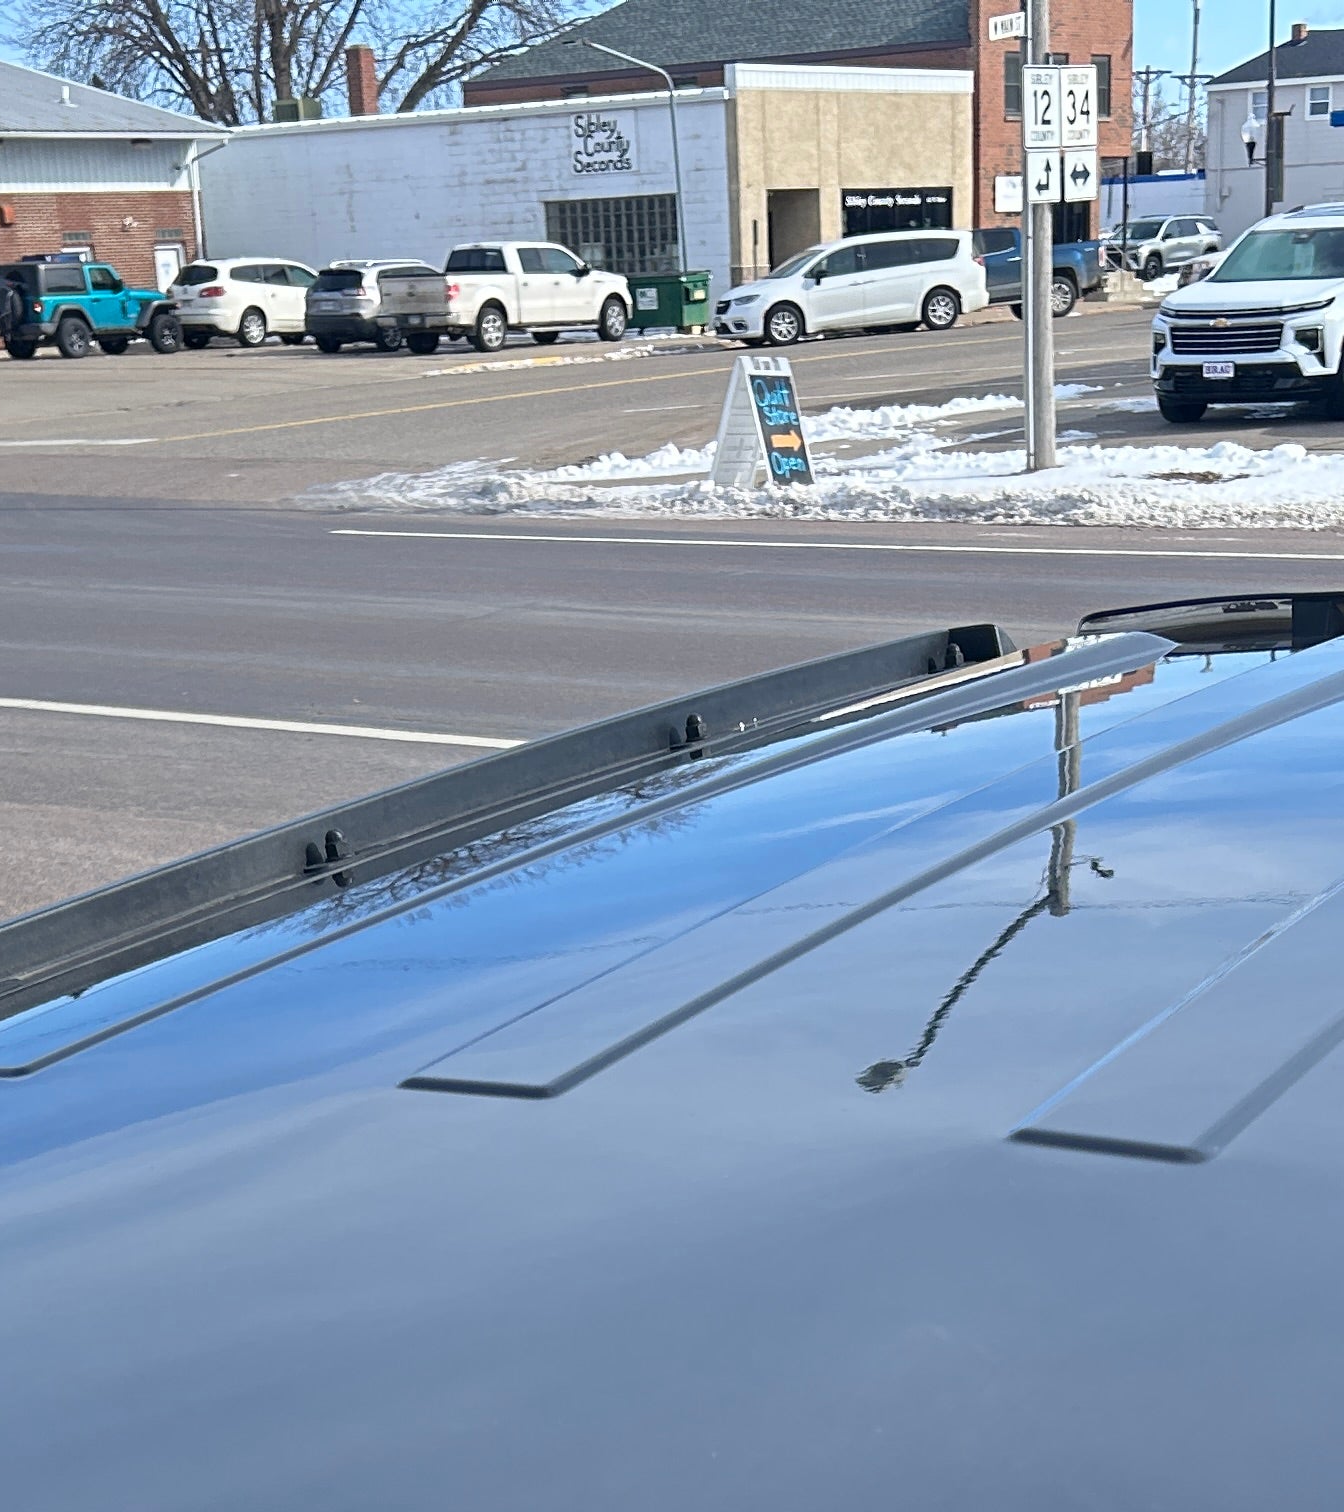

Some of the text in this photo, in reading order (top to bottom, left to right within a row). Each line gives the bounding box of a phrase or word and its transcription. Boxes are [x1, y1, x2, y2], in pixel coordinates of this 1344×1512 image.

[1033, 89, 1052, 126] 12
[1066, 89, 1090, 125] 34
[573, 151, 633, 173] Seconds
[771, 451, 807, 479] Open
